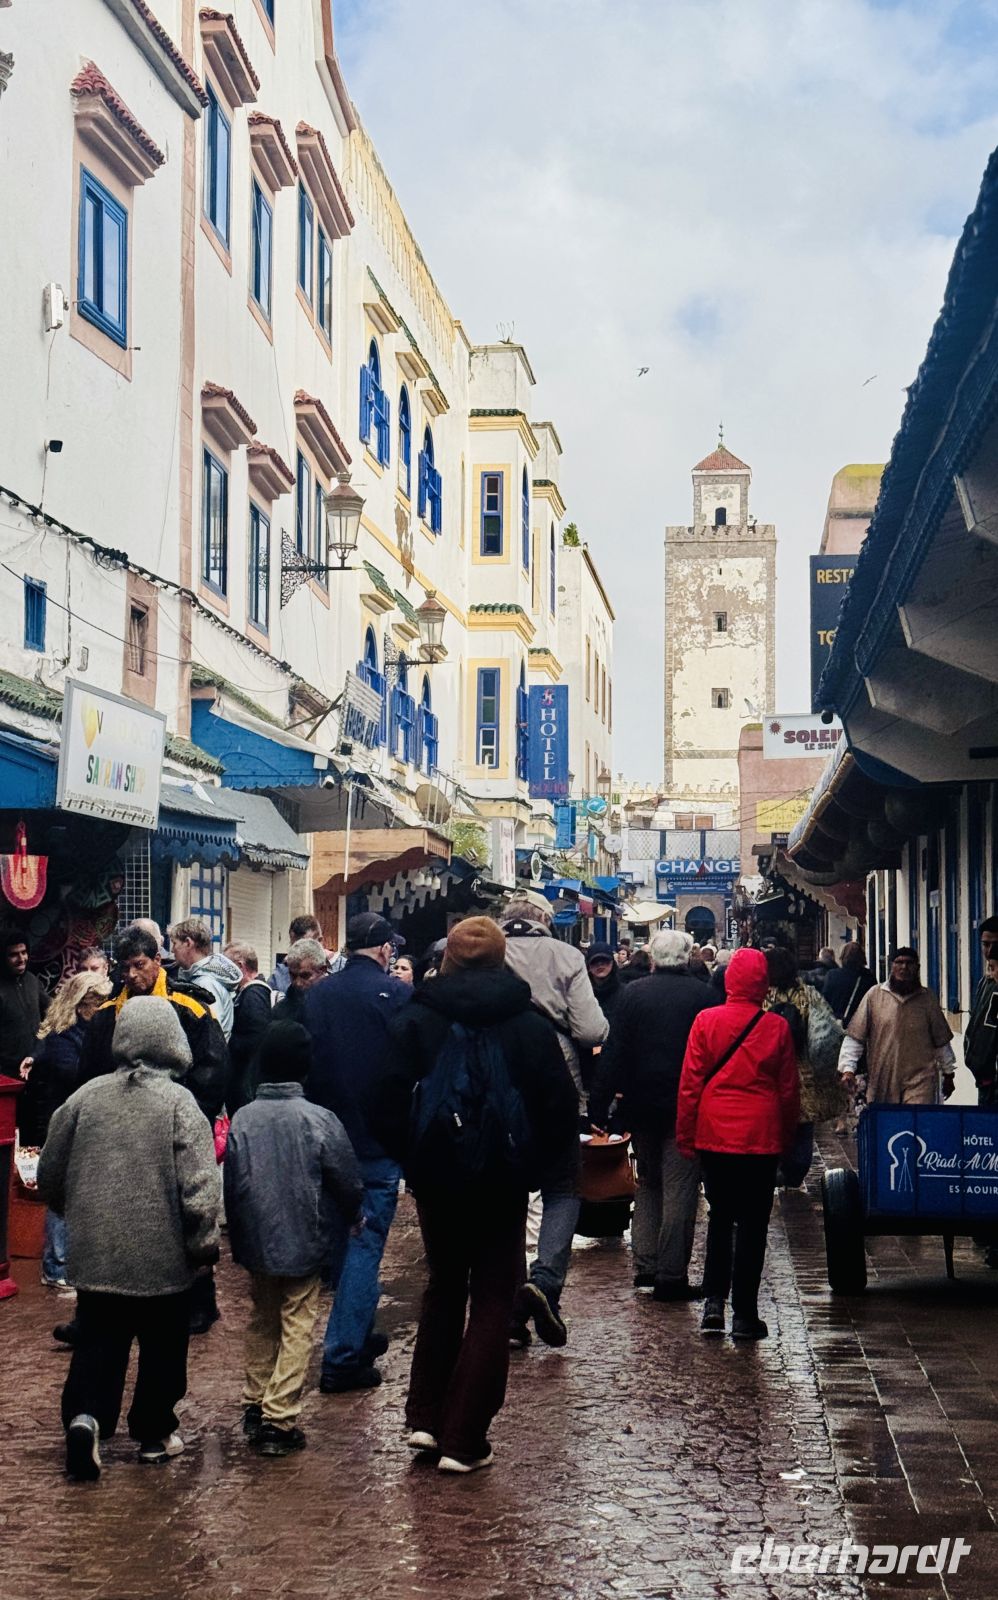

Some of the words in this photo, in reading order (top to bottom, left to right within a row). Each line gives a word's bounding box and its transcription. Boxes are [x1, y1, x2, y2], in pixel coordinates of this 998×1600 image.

[540, 708, 557, 780] HOTEL
[804, 743, 815, 751] LE
[657, 861, 741, 873] CHANGE
[963, 1135, 993, 1146] HÔTEL
[923, 1151, 957, 1171] Riad
[949, 1185, 998, 1195] ESAOUIR
